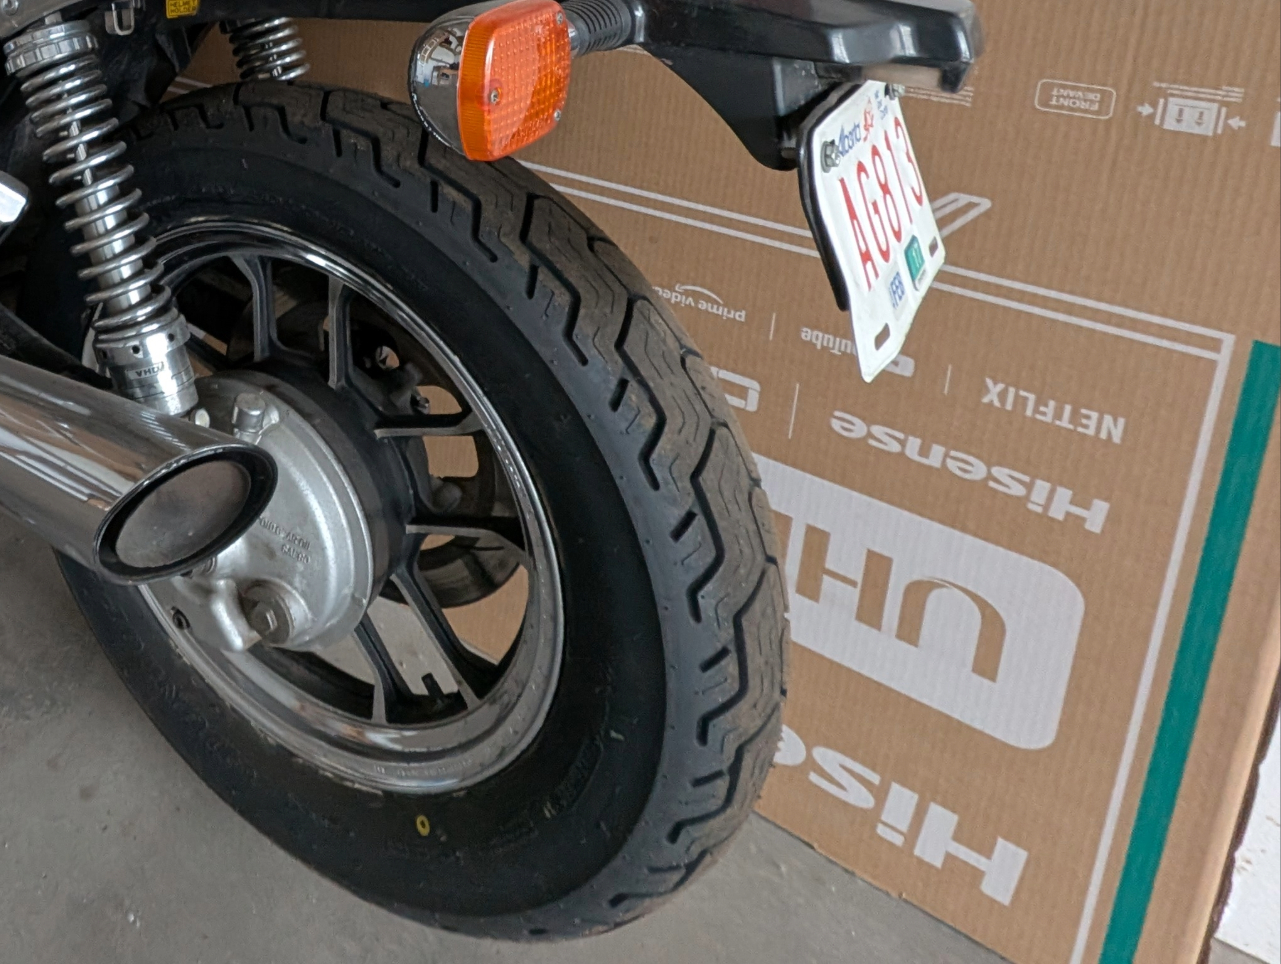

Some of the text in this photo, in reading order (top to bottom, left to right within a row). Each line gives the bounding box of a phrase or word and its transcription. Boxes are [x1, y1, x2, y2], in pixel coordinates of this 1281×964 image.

[170, 0, 196, 8] HELMET
[1049, 96, 1099, 111] FRONT
[838, 116, 923, 292] AG813
[698, 299, 746, 322] prime
[981, 378, 1125, 444] NETFLIX
[830, 410, 1110, 534] Hisense
[773, 509, 1007, 683] UH
